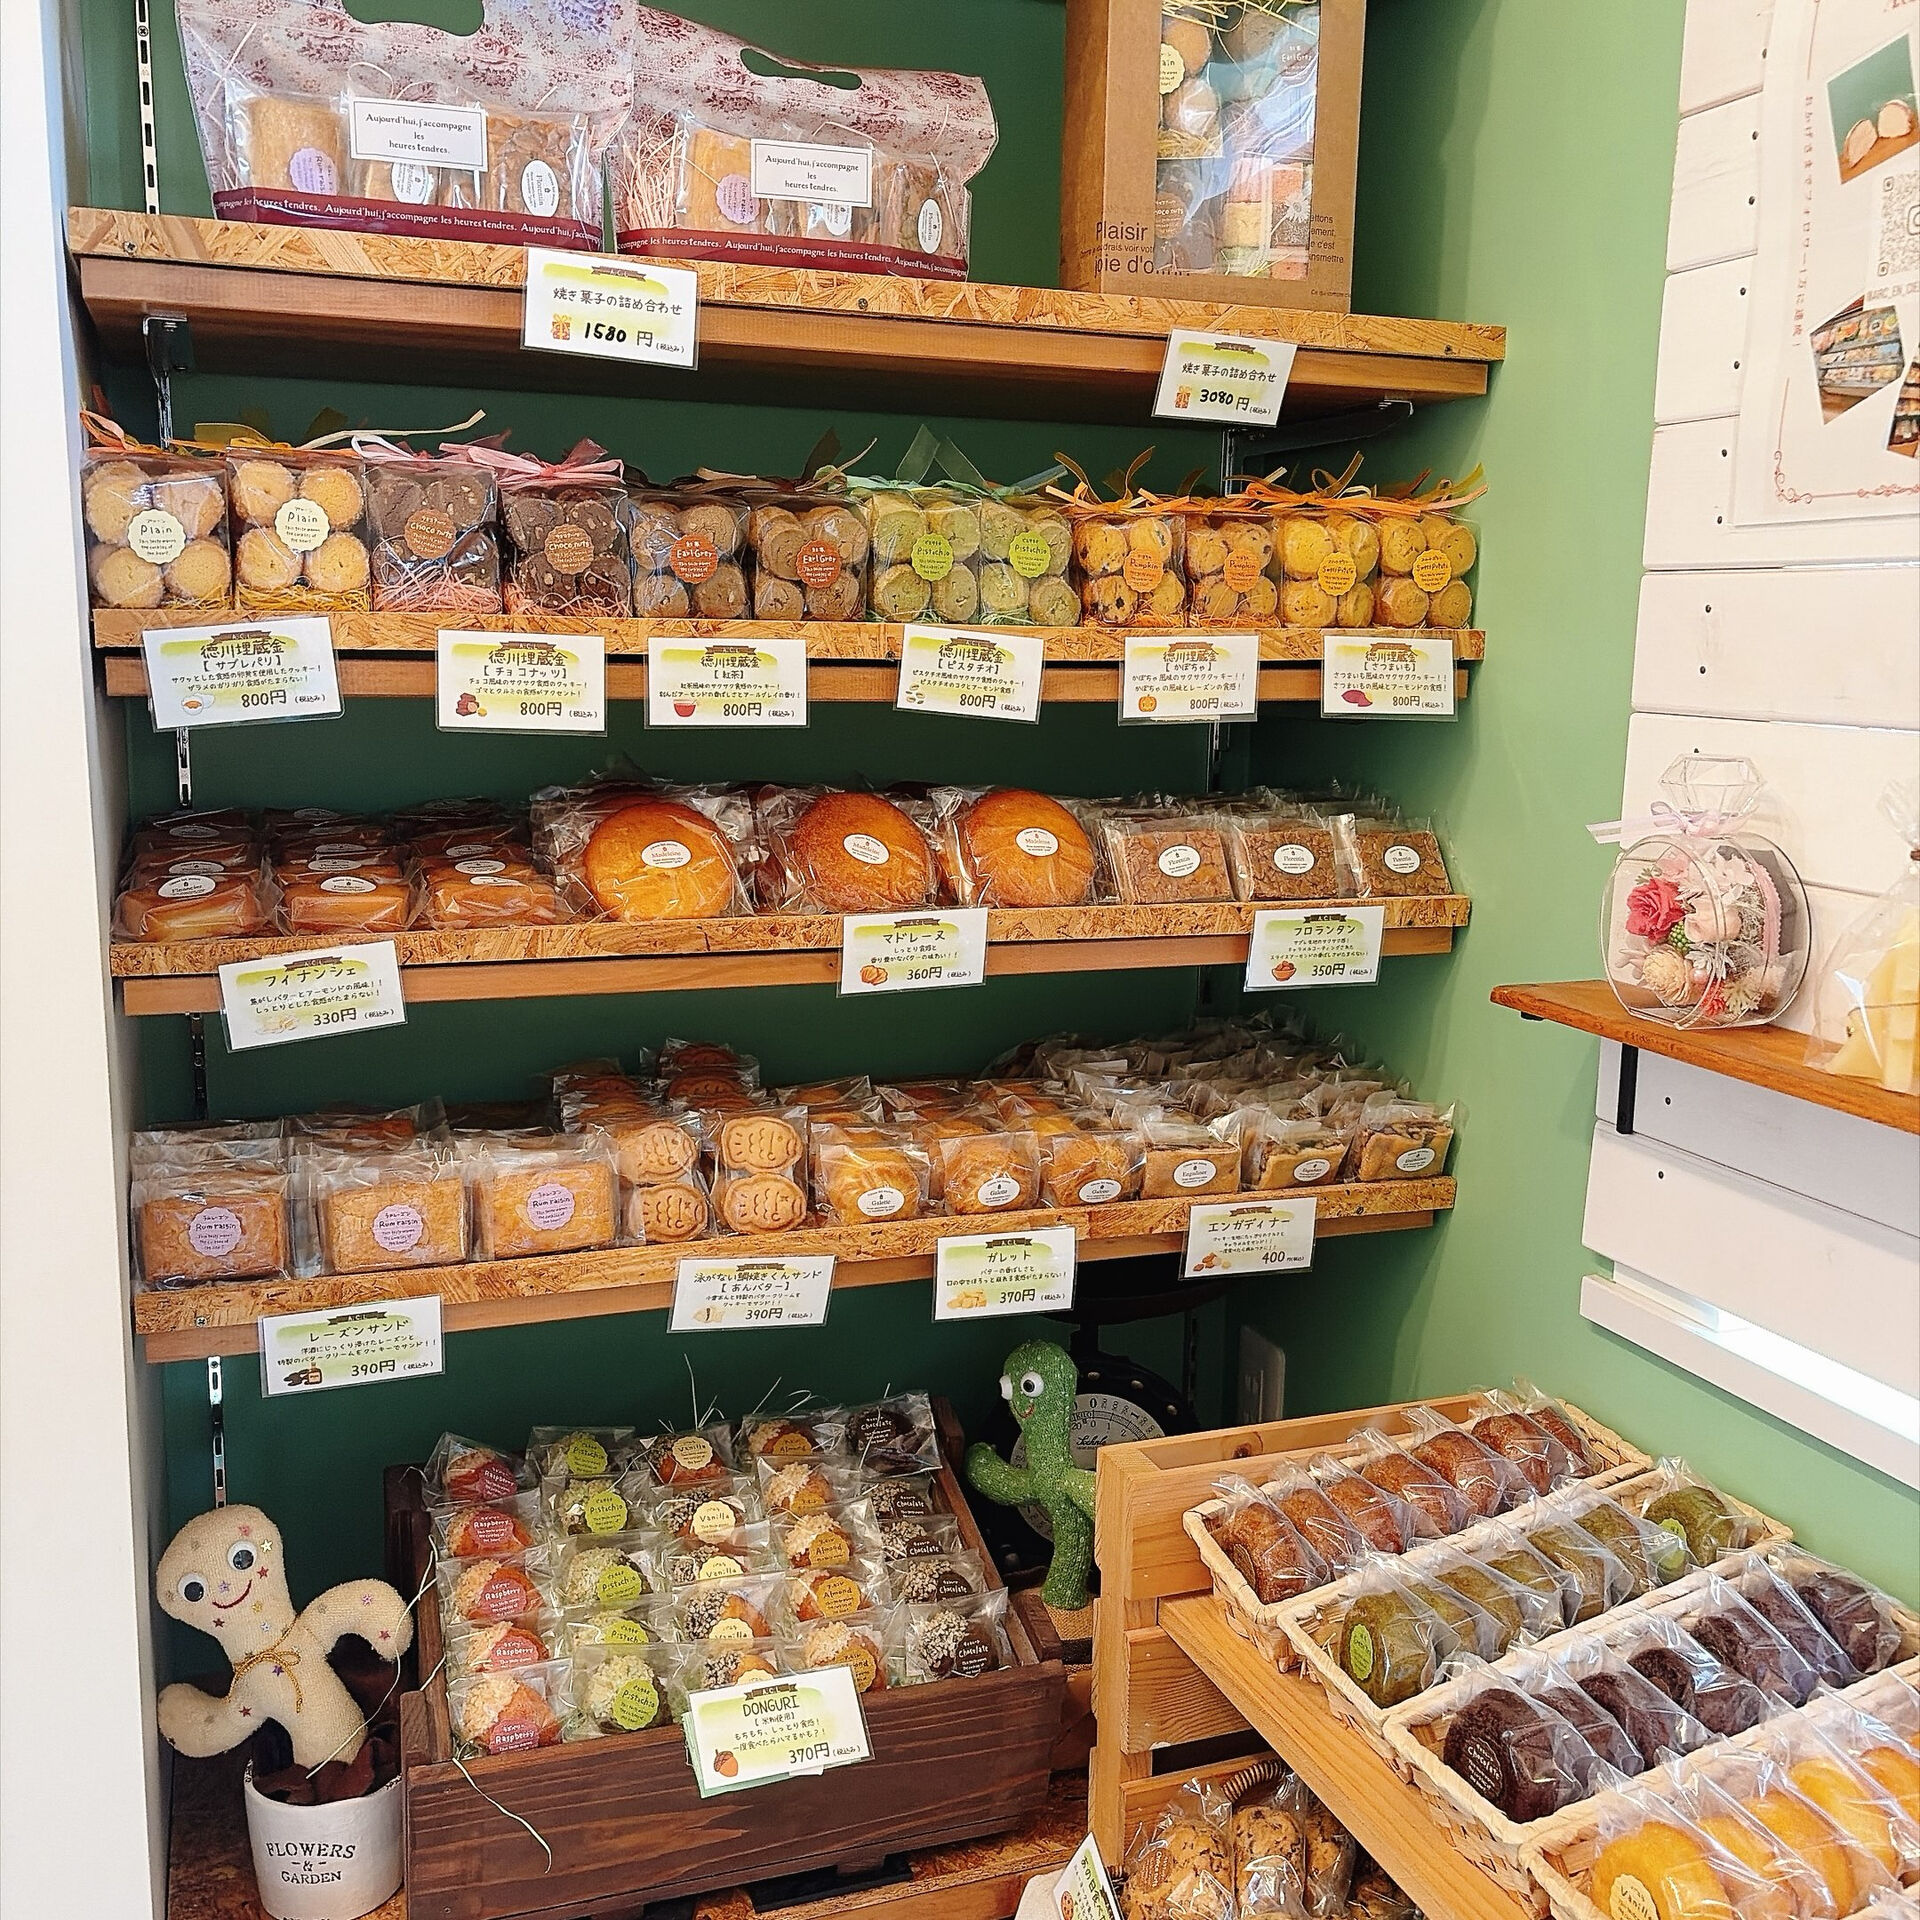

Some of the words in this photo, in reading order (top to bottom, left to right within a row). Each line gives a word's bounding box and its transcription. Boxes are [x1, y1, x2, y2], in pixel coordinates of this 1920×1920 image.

[414, 131, 425, 141] les
[388, 140, 419, 151] heures
[419, 141, 450, 154] tendres.
[808, 172, 817, 180] les
[784, 179, 810, 190] heures
[811, 182, 838, 193] tendres.
[283, 200, 320, 211] tendres.
[325, 204, 381, 218] Aujourd'hui,
[441, 215, 452, 224] les
[454, 218, 481, 227] heures
[483, 220, 517, 231] tendres.
[1096, 221, 1148, 240] Plaisir
[650, 236, 660, 245] les
[662, 236, 688, 246] heures
[689, 238, 721, 248] tendres.
[725, 240, 774, 253] Aujourd'hui,
[827, 248, 837, 257] les
[839, 250, 863, 260] heures
[553, 287, 683, 316] 焼き菓子の詰め合わせ
[1182, 362, 1277, 383] 焼き菓子の詰め合わせ
[287, 512, 318, 523] Plain
[140, 524, 173, 536] Plain
[200, 639, 286, 659] 徳川埋蔵金
[939, 645, 1006, 664] 徳川埋蔵金
[488, 651, 568, 667] 徳川埋蔵金
[701, 656, 762, 668] 徳川埋蔵金
[1163, 651, 1219, 662] 徳川埋蔵金
[1366, 651, 1418, 663] 徳川埋蔵金
[241, 689, 287, 708] 800円
[959, 694, 996, 709] 800円
[1189, 697, 1219, 710] 800円
[1393, 695, 1421, 707] 800円
[520, 702, 562, 717] 800円
[723, 702, 762, 717] 800円
[883, 930, 946, 944] マドレーヌ
[1294, 925, 1356, 936] フロランタン
[264, 966, 357, 988] フィナンシェ
[907, 966, 942, 981] 360円
[1311, 963, 1346, 977] 350円
[313, 1008, 357, 1026] 330円
[1208, 1217, 1290, 1233] エンガディナー
[987, 1250, 1032, 1263] ガレット
[1262, 1251, 1286, 1264] 400
[1000, 1288, 1036, 1304] 370円
[745, 1307, 783, 1320] 390円
[310, 1319, 409, 1342] レーズンサンド
[351, 1359, 396, 1377] 390円
[677, 1442, 706, 1452] Vanilla
[590, 1502, 624, 1514] Pistachio
[473, 1519, 509, 1529] Raspberry
[700, 1512, 730, 1522] Vanilla
[816, 1543, 842, 1556] Almond
[705, 1567, 737, 1578] Vanilla
[484, 1586, 521, 1601] Raspberry
[823, 1587, 852, 1598] Almond
[496, 1646, 535, 1657] Raspberry
[958, 1646, 989, 1658] Chocolate
[622, 1690, 656, 1709] Pistachio
[743, 1695, 800, 1717] DONGURI
[495, 1730, 535, 1746] Raspberry
[788, 1742, 830, 1764] 370円
[266, 1842, 356, 1859] FLOWERS
[281, 1870, 342, 1885] GARDEN
